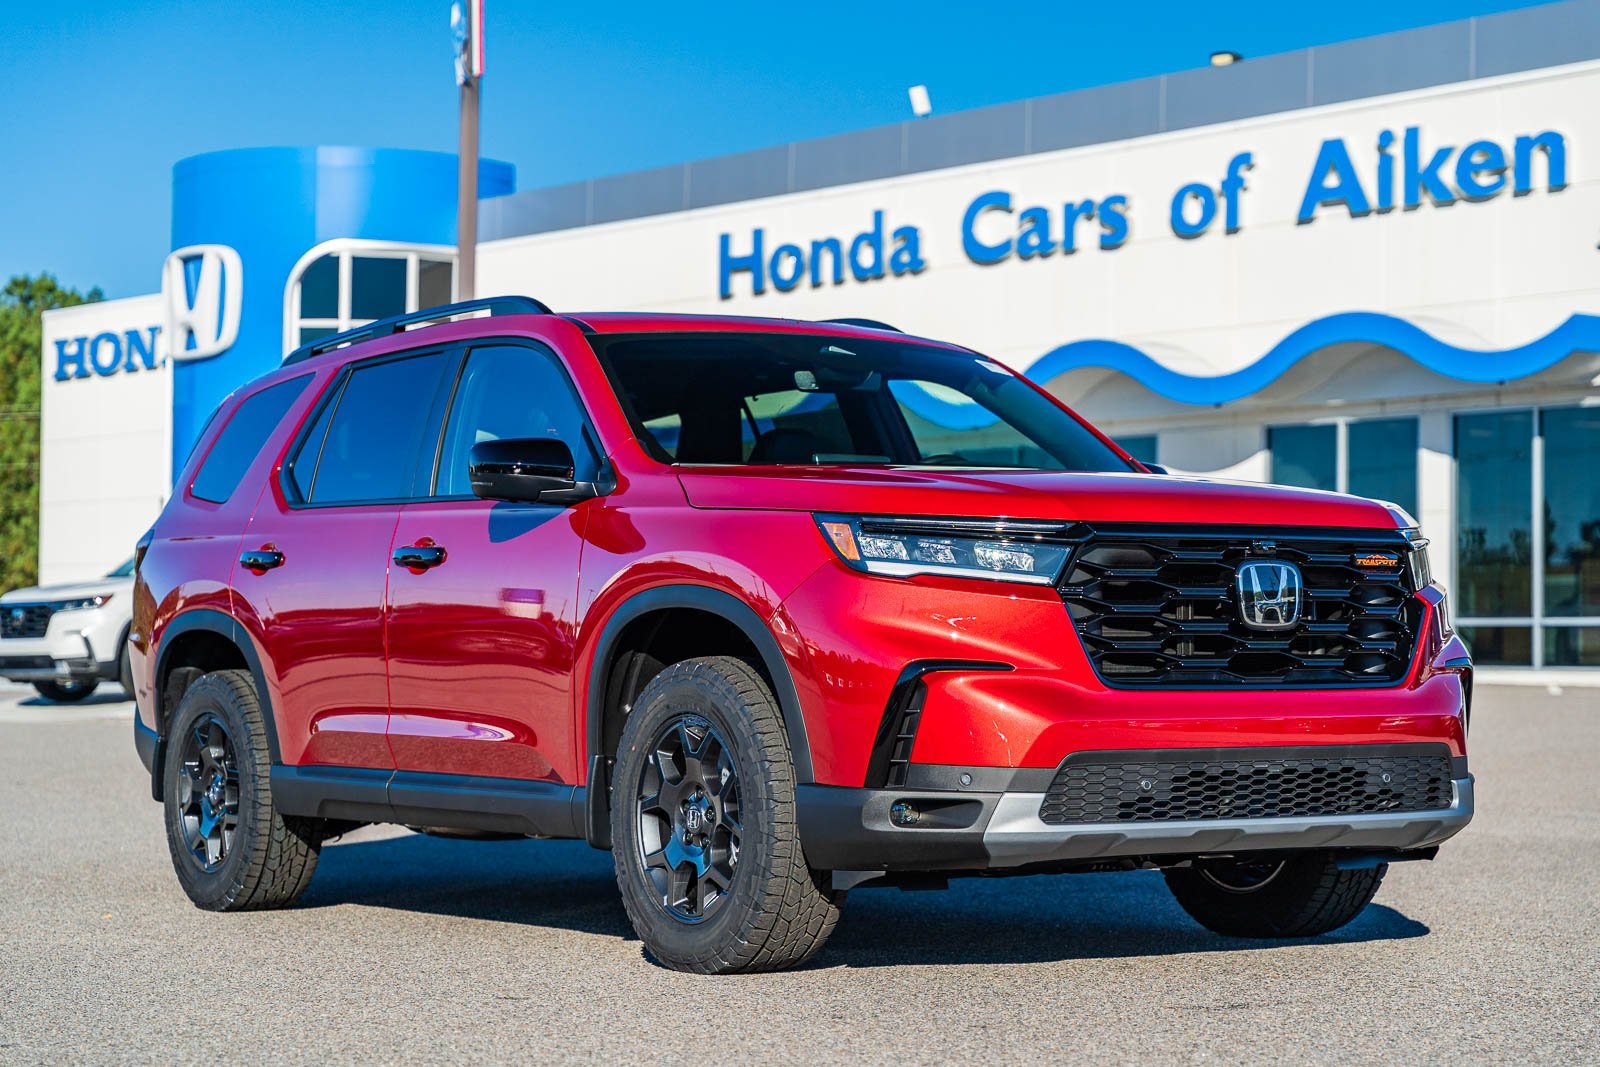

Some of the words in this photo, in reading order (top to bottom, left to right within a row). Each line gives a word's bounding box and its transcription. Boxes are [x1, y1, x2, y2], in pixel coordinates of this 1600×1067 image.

[719, 210, 926, 299] Honda
[962, 191, 1129, 264] Cars
[1170, 152, 1253, 238] of
[1298, 126, 1567, 223] Aiken
[53, 326, 166, 382] HON
